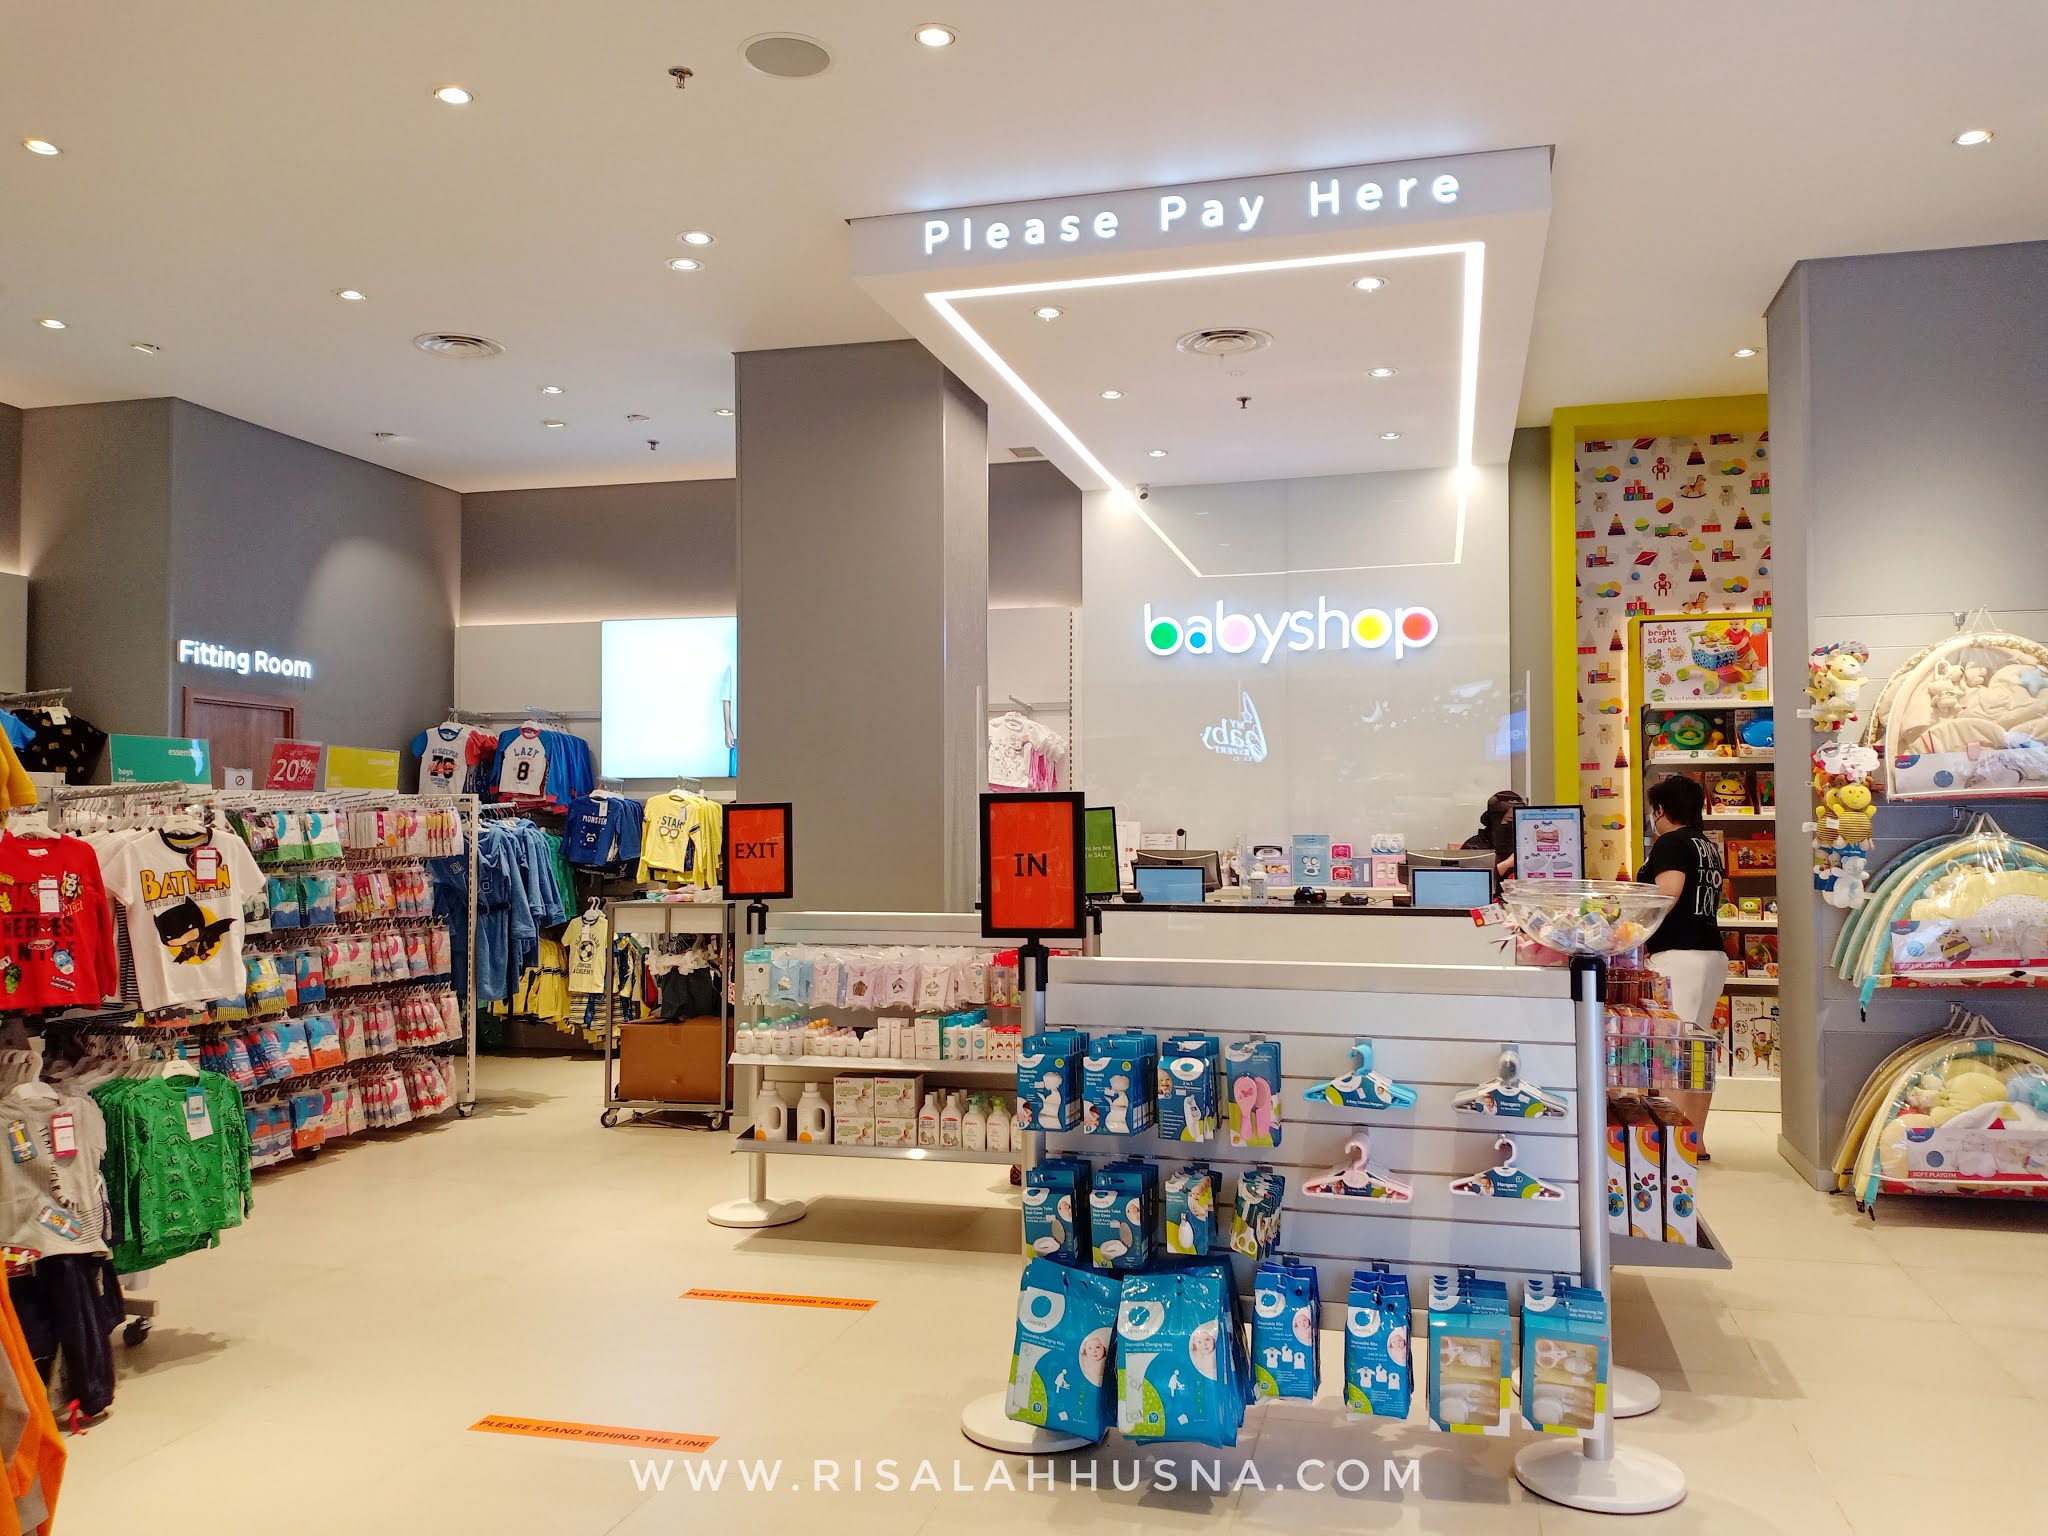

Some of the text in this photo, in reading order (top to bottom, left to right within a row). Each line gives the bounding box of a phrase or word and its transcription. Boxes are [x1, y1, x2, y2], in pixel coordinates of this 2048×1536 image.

[924, 172, 1461, 254] Please Pay Here
[1143, 595, 1439, 664] babyshop
[1648, 628, 1677, 637] bright
[177, 638, 312, 679] Fitting Room
[513, 747, 540, 759] LAZY
[273, 758, 312, 782] 20%
[516, 761, 530, 781] 8
[582, 815, 608, 826] MONSTER
[734, 841, 779, 860] EXIT
[1013, 852, 1049, 878] IN
[3, 917, 74, 938] HERES
[1500, 1100, 1521, 1108] Hangers
[1497, 1181, 1518, 1189] Hangers
[1929, 1171, 1957, 1179] PLAYGYM
[478, 1420, 711, 1448] PLEASE STAND BEHIND THE LINE
